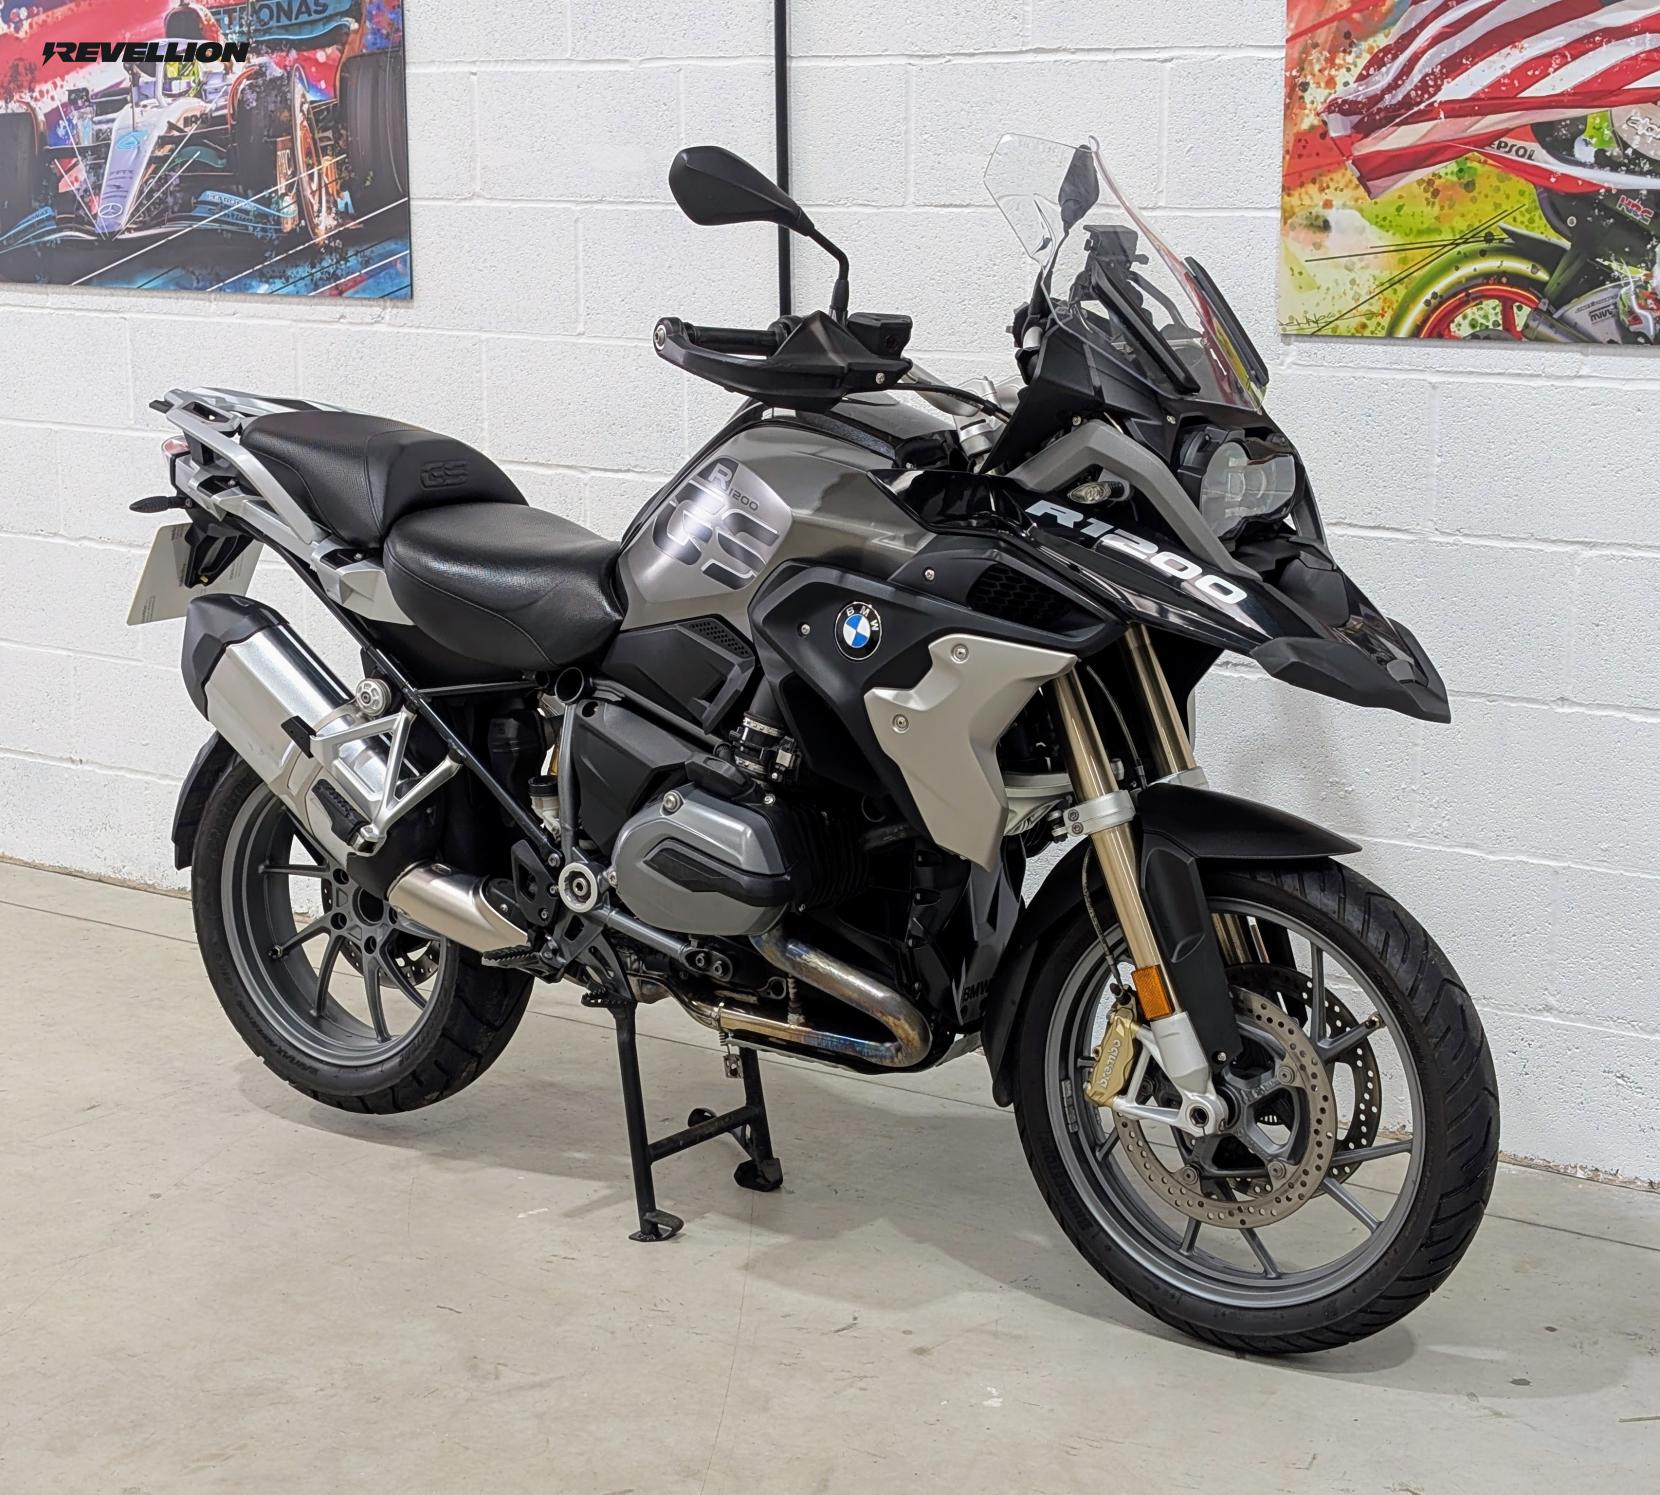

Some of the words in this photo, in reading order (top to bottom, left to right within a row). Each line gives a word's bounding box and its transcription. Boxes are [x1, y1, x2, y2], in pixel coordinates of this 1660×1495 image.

[420, 460, 470, 490] GS
[708, 463, 733, 492] R
[729, 486, 760, 512] 1200
[1025, 500, 1248, 604] R1200
[846, 605, 880, 631] BMW
[962, 978, 992, 1003] BMW
